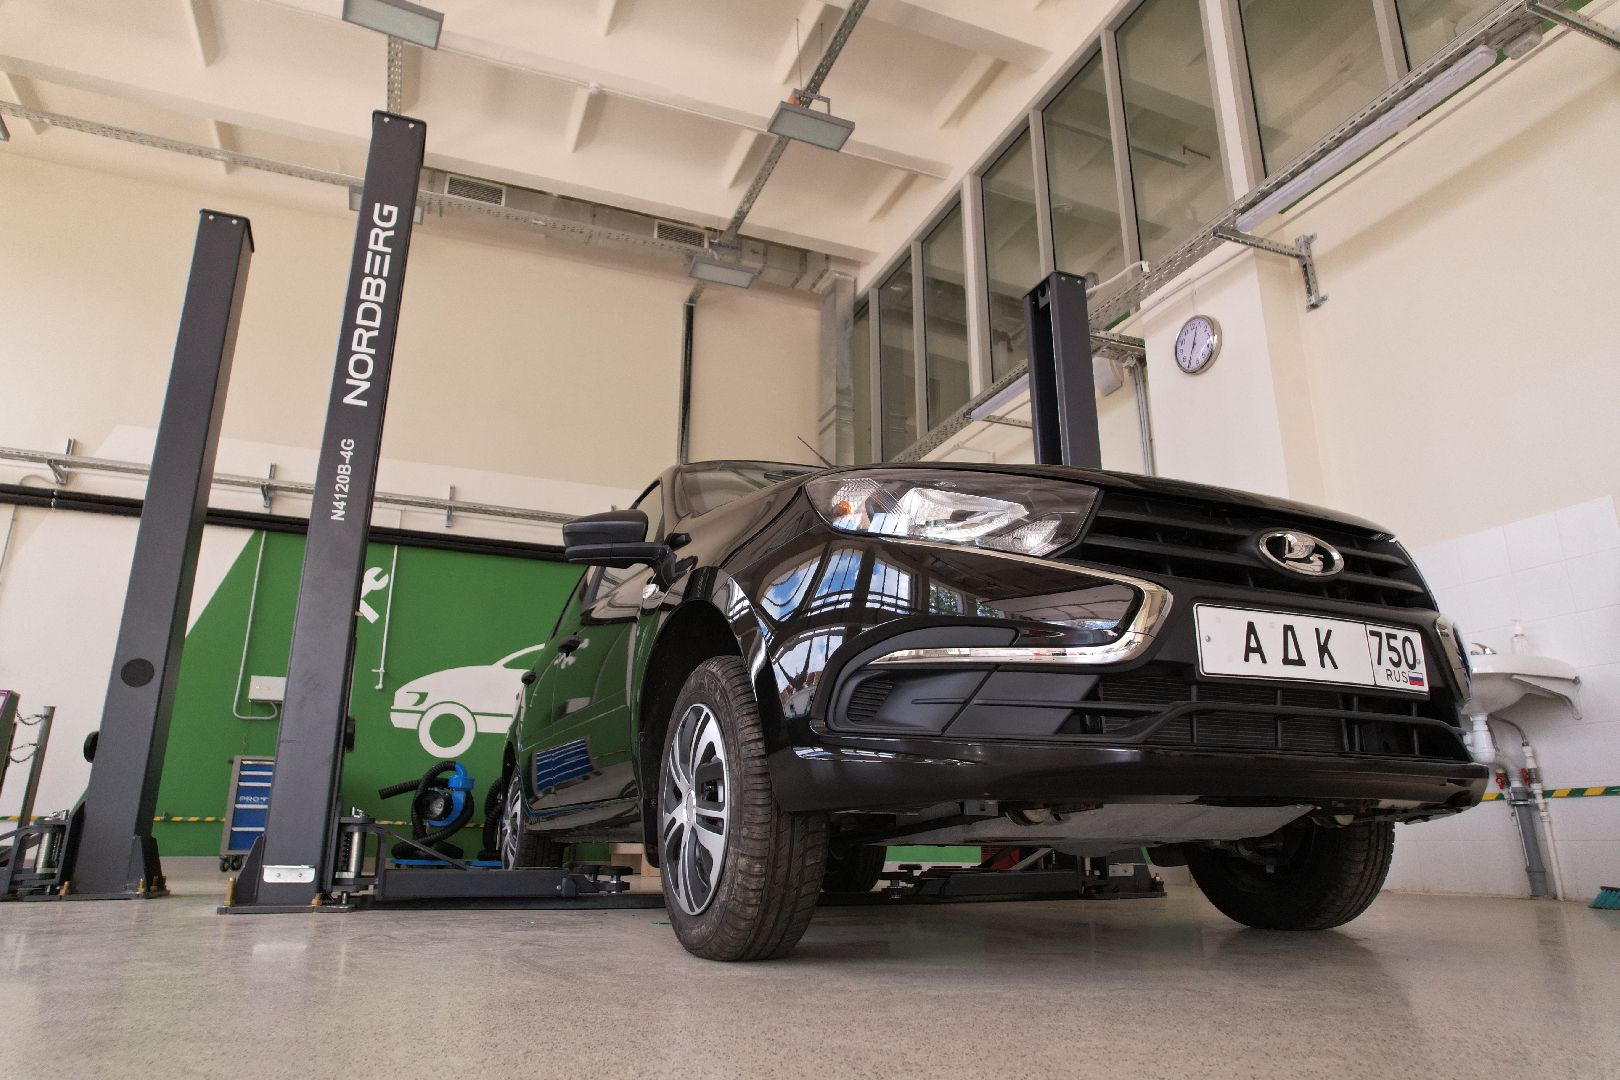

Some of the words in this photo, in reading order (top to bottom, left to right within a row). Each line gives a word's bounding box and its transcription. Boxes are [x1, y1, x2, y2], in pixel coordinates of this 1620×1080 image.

[342, 202, 399, 408] NORDBERG
[330, 437, 356, 523] N4120B-4G
[1368, 629, 1417, 670] 750
[1385, 668, 1408, 684] RUS
